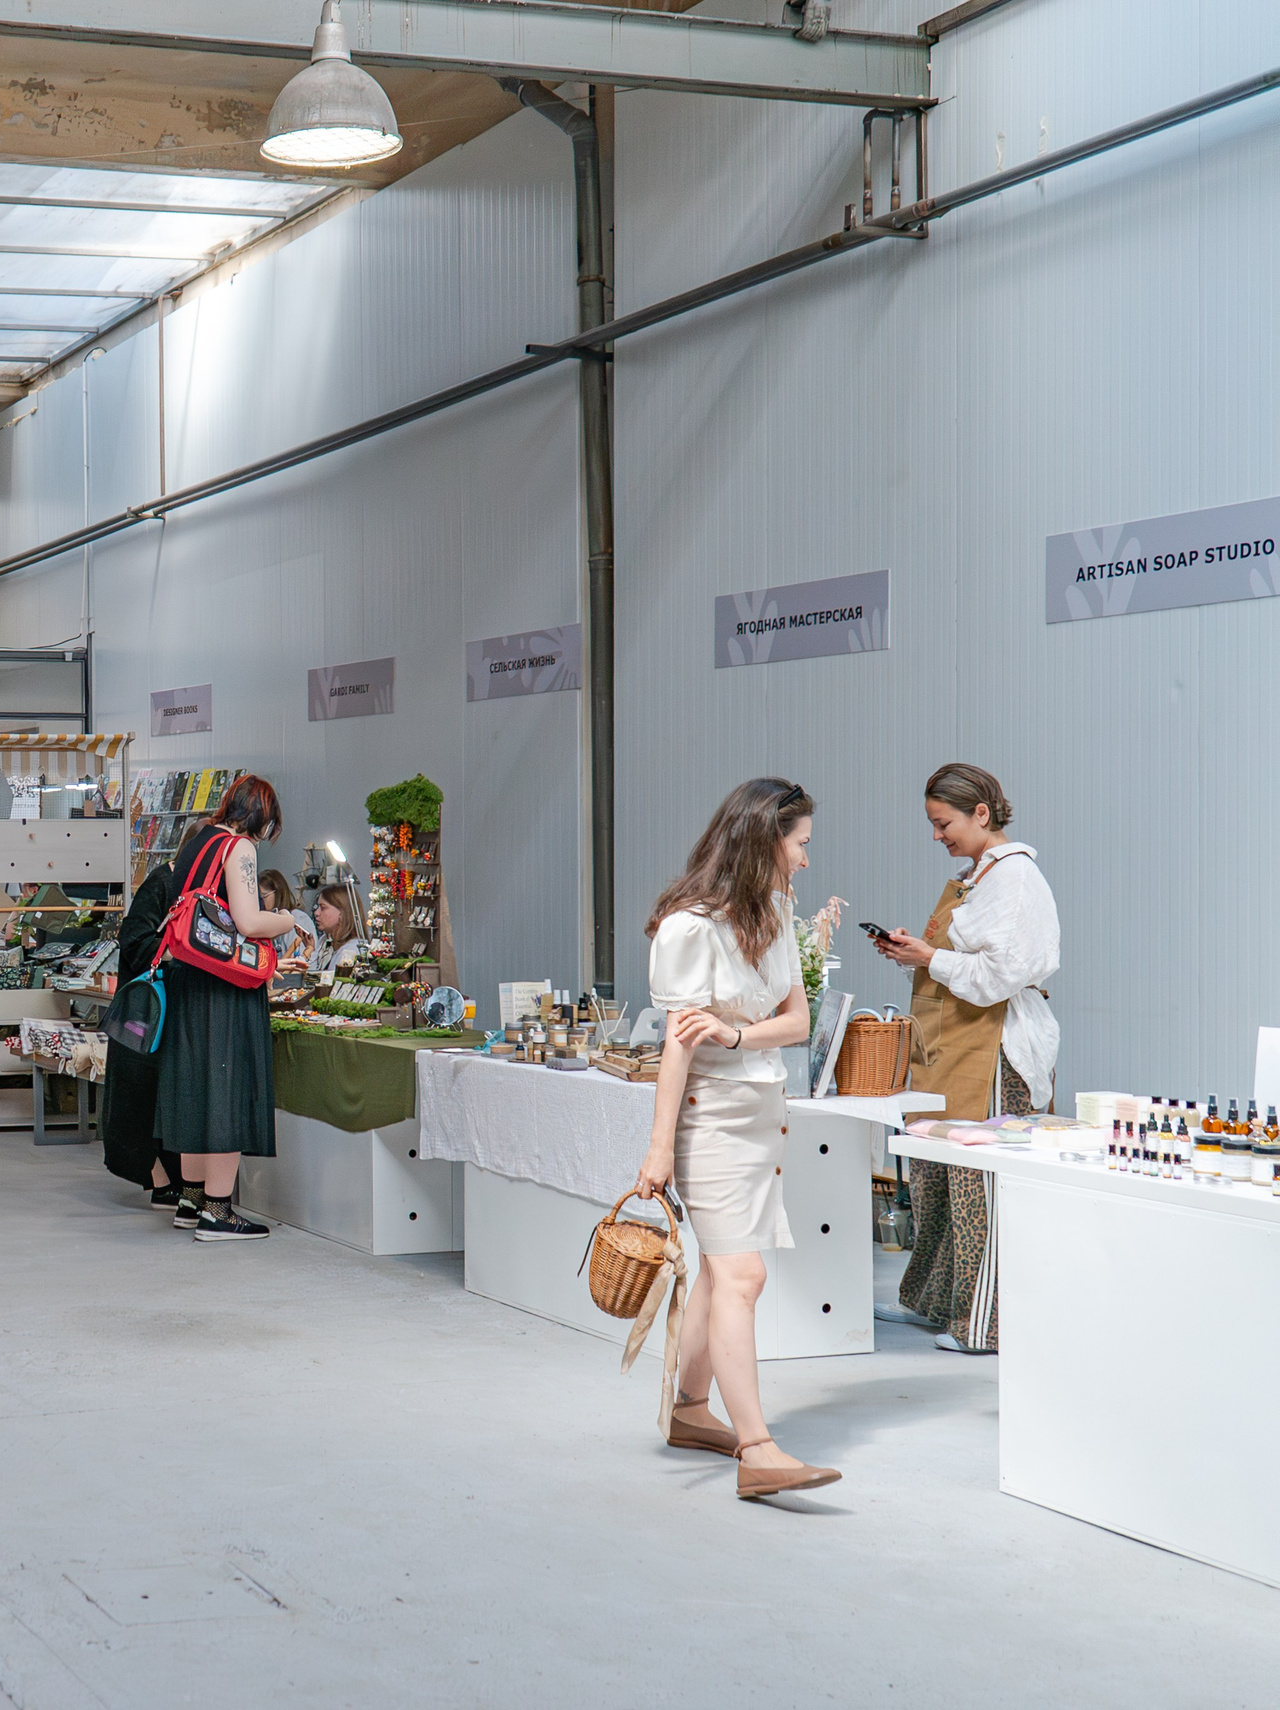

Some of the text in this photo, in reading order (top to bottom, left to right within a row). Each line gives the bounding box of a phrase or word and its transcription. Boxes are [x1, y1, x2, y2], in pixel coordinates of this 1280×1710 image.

[1076, 538, 1275, 582] ARTISAN SOAP STUDIO
[736, 606, 863, 635] ЯГОДНАЯ МАСТЕРСКАЯ
[489, 655, 556, 674] СЕЛЬСКАЯ ЖИЗНЬ
[349, 683, 370, 695] FAMILY
